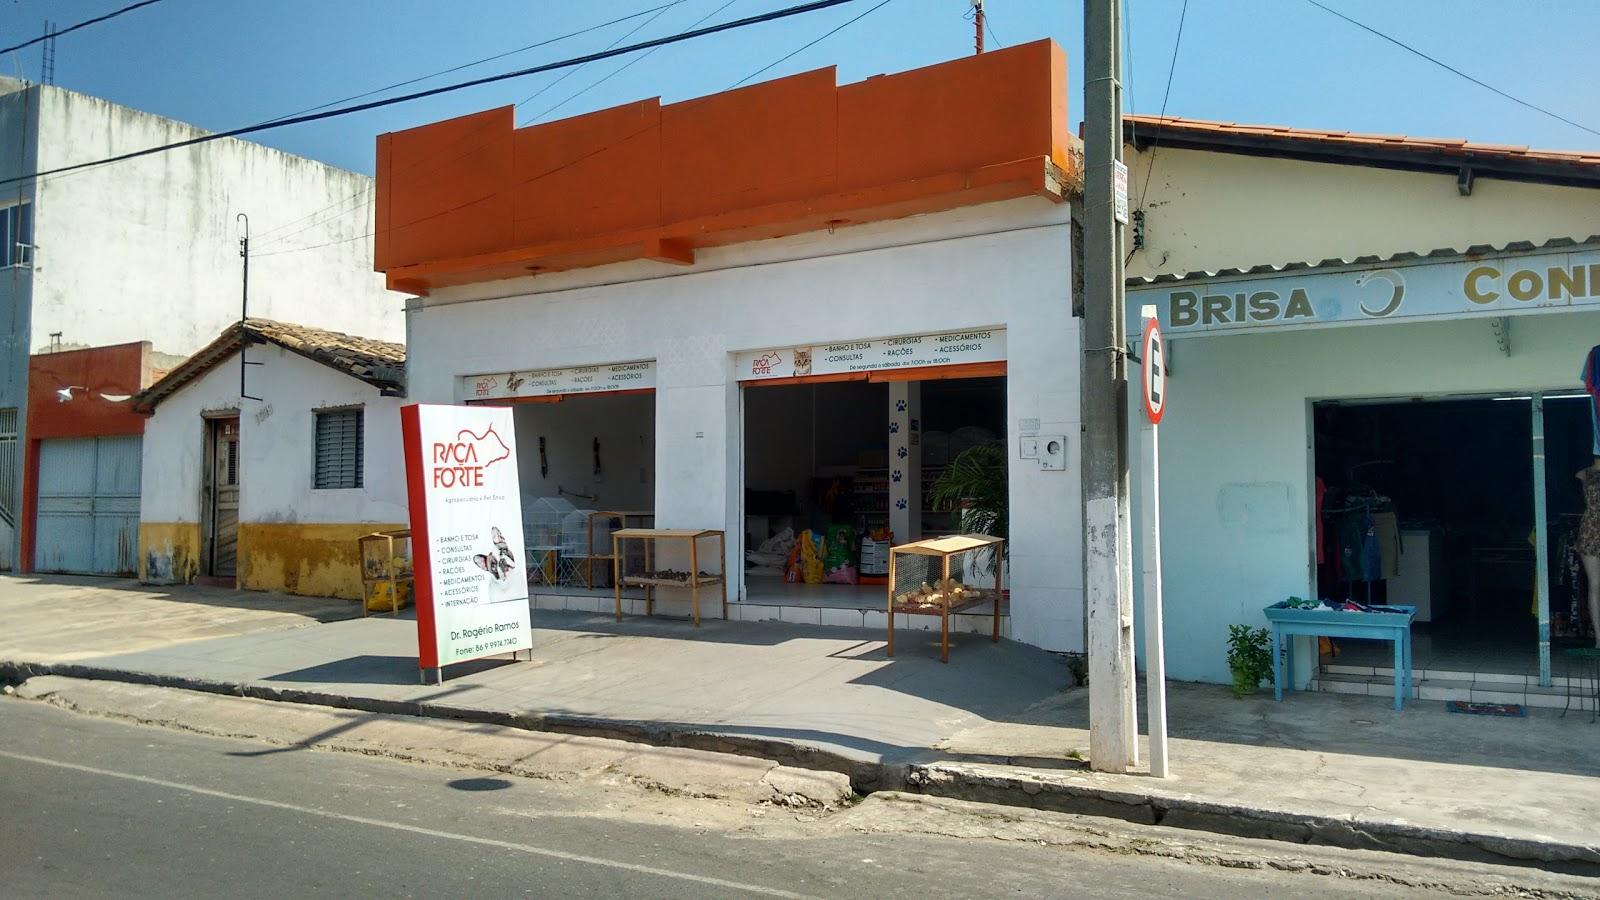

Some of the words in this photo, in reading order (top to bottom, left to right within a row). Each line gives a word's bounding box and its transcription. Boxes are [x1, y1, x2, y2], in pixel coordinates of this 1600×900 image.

[1169, 288, 1315, 328] BRISA
[887, 336, 922, 346] CIRURGIAS
[939, 332, 991, 343] MEDICAMENTOS
[829, 345, 850, 353] BANHO
[856, 342, 872, 350] TOSA
[887, 347, 913, 357] RAÇÕES
[939, 343, 982, 353] ACESSÓRIOS
[828, 353, 863, 362] CONSULTAS
[611, 363, 649, 372] MEDICAMENTOS
[752, 366, 771, 375] FORTE
[1151, 338, 1161, 405] E
[611, 373, 642, 381] ACESSÓRIOS
[433, 466, 484, 488] FORTE
[440, 535, 460, 544] BANHO
[465, 533, 479, 541] TOSA
[441, 545, 473, 554] CONSULTAS
[441, 555, 472, 565] CIRURGIAS
[443, 574, 486, 586] MEDICAMENTOS
[444, 585, 479, 597] ACESSÓRIOS
[444, 596, 479, 608] INTERNAÇÃO
[450, 631, 462, 641] Dr.
[462, 625, 494, 639] Rogério
[494, 621, 520, 633] Ramos
[455, 647, 475, 656] Fone:
